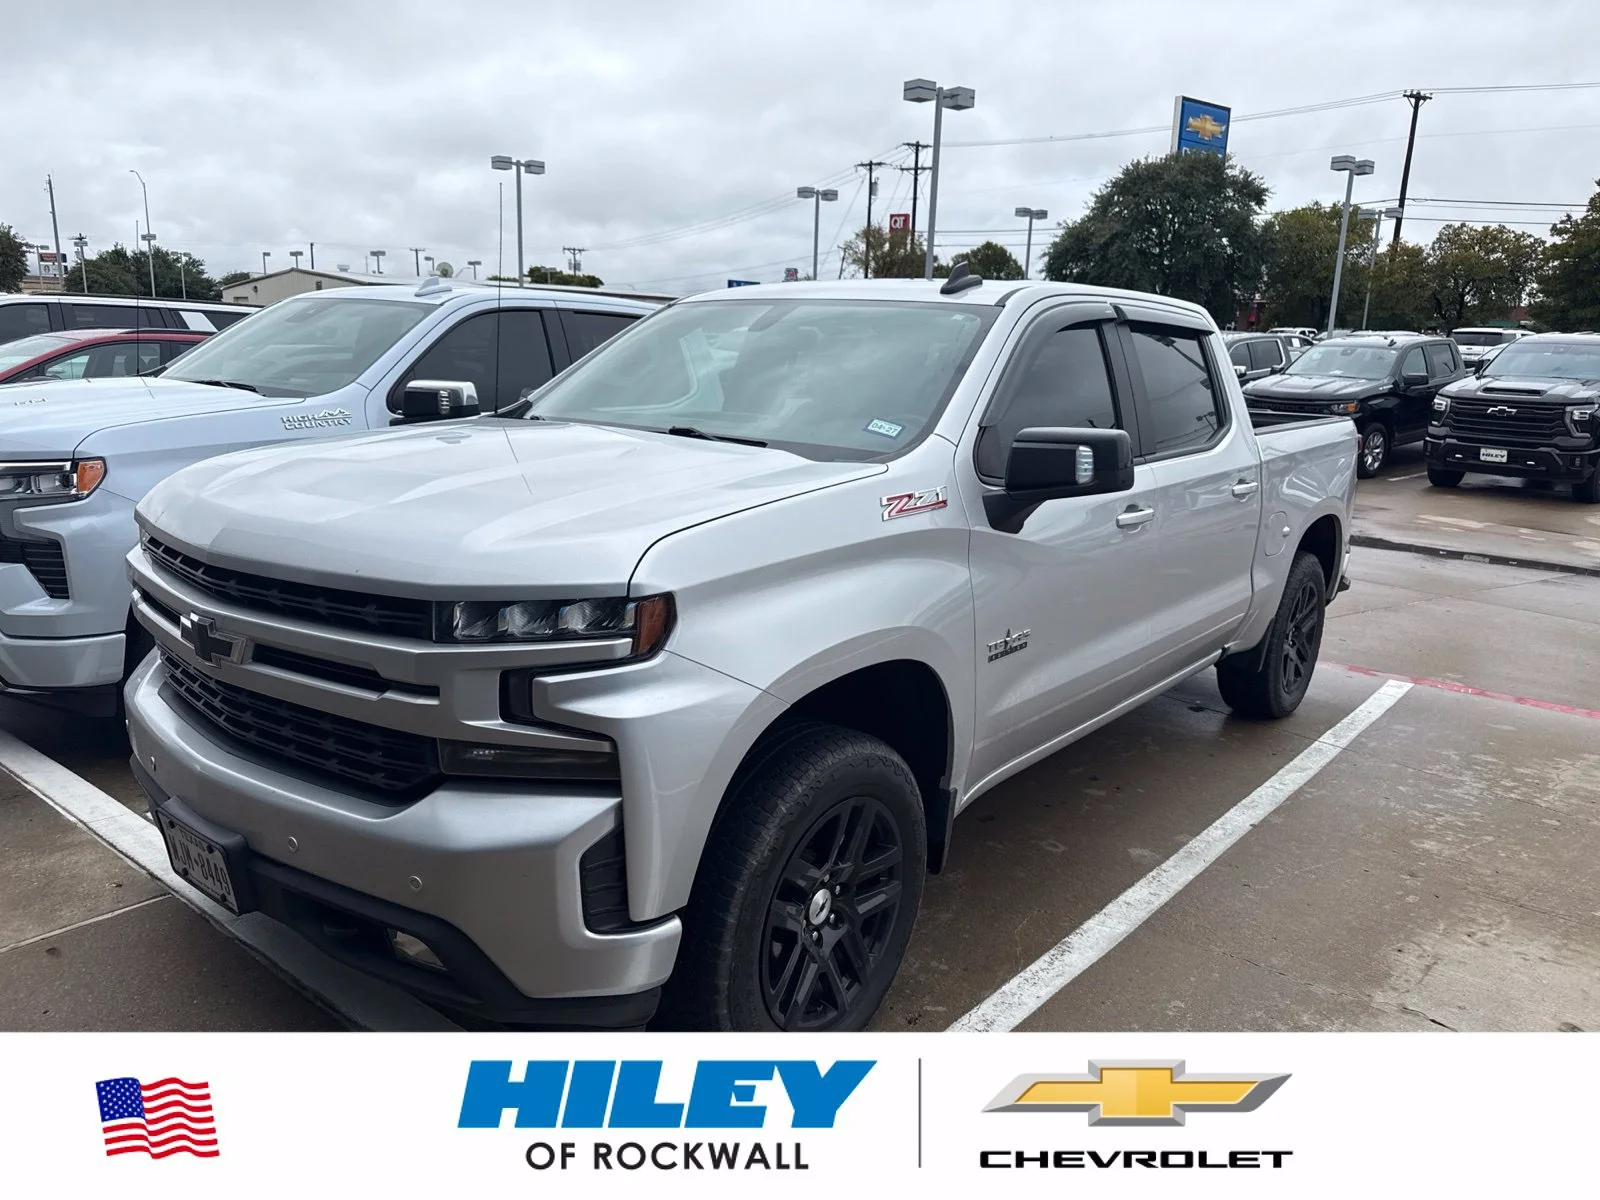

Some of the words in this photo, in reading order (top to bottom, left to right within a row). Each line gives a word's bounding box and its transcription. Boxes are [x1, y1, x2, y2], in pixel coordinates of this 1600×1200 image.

[891, 216, 904, 229] QT
[281, 414, 318, 423] HIGH
[284, 419, 351, 430] COUNTRY
[880, 486, 948, 521] Z71
